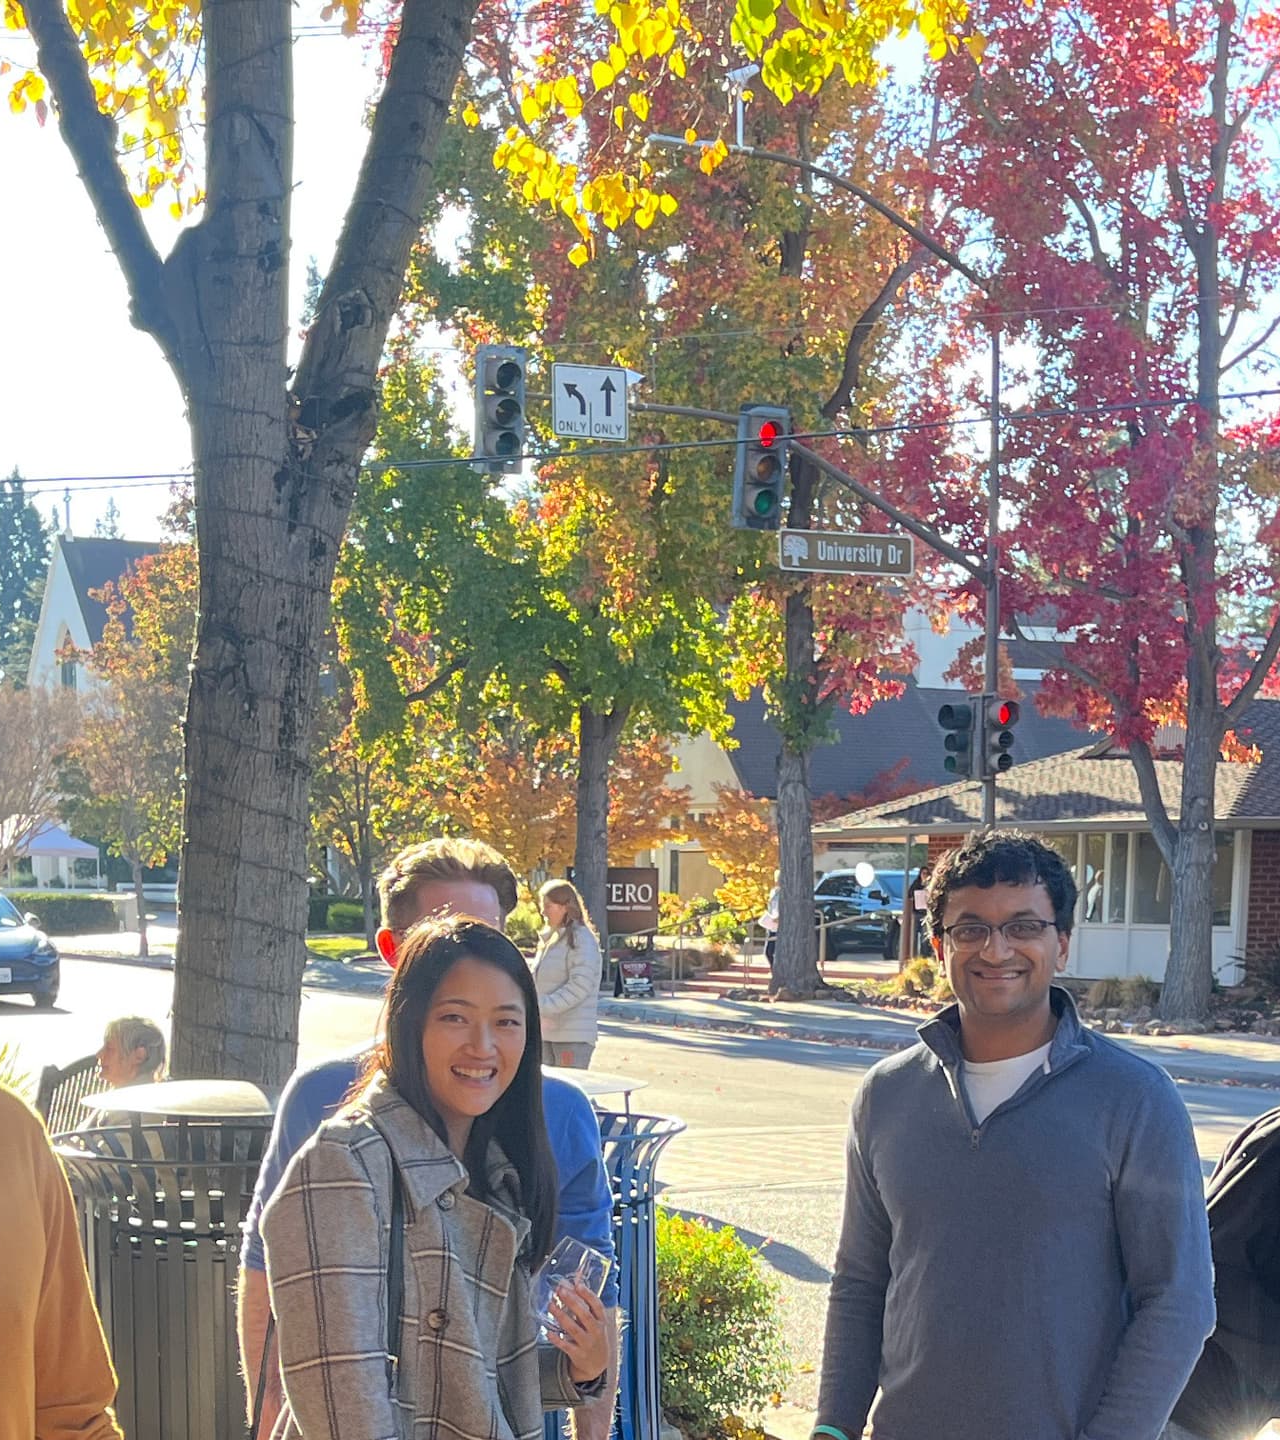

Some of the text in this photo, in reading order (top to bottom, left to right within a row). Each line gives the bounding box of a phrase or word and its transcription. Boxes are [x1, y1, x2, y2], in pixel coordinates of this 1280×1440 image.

[558, 420, 587, 433] ONLY
[594, 423, 623, 436] ONLY
[817, 541, 903, 567] University Dr
[606, 883, 653, 903] ERO
